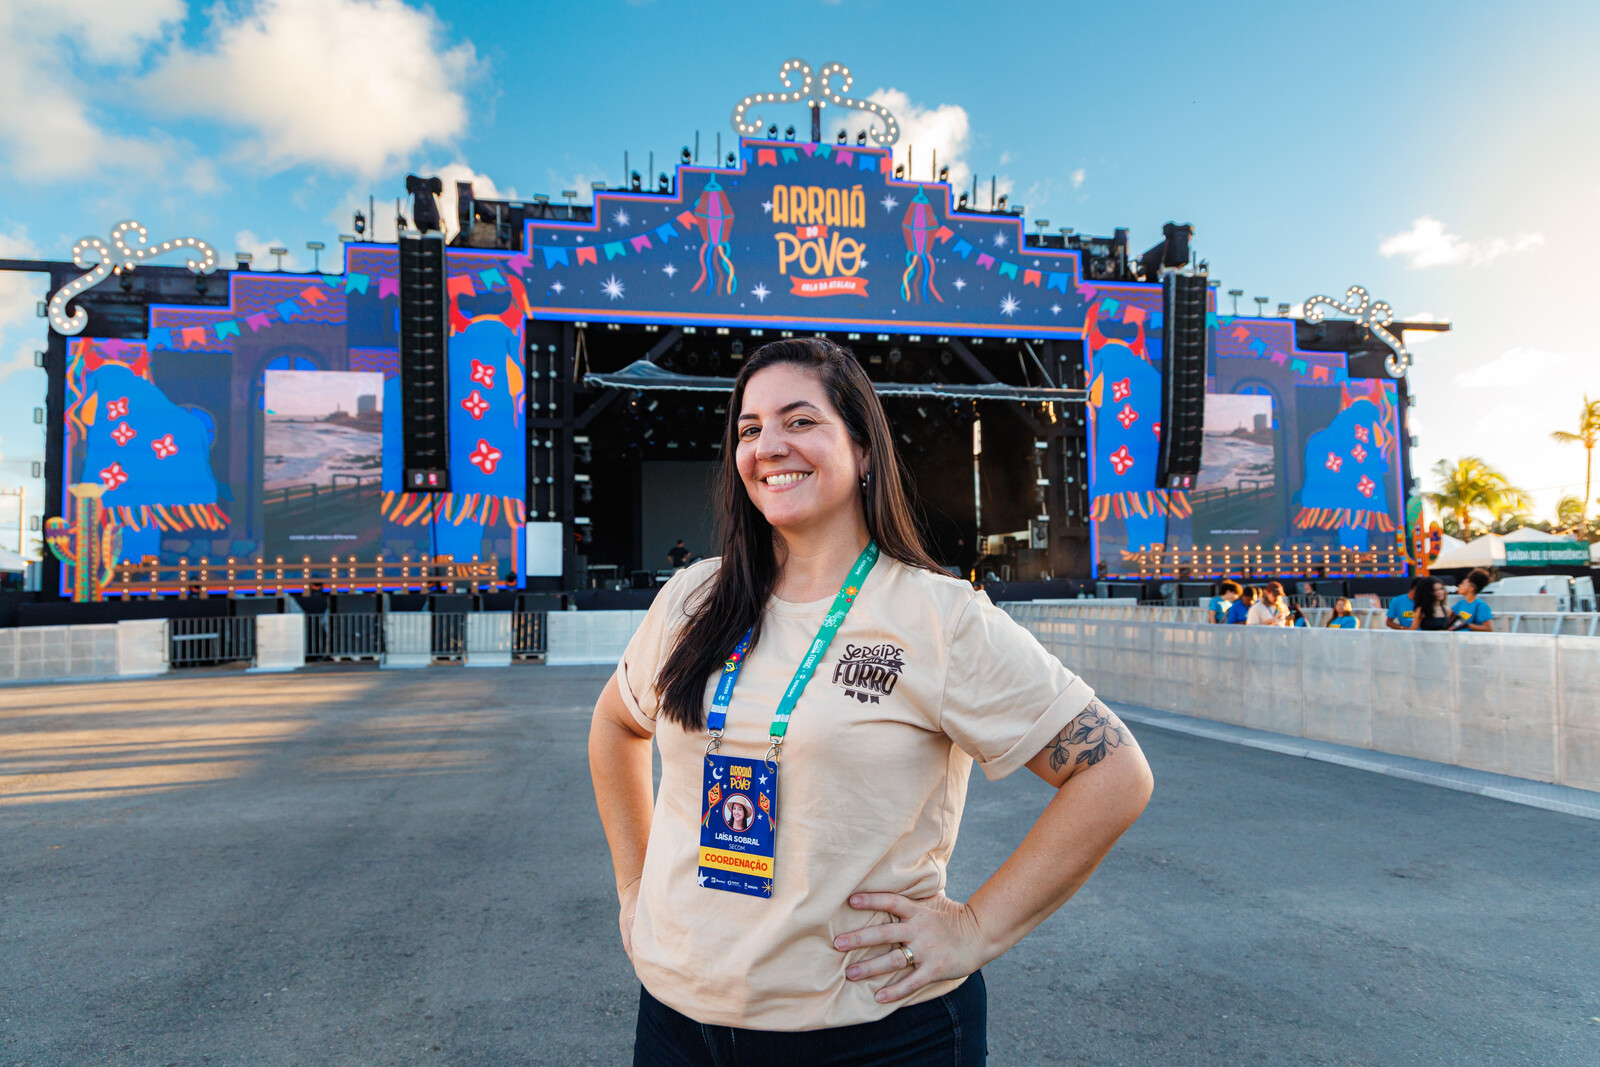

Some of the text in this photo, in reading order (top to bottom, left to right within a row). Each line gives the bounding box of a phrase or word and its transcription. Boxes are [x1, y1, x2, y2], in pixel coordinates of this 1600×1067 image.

[772, 184, 866, 228] ARRAIÁ
[805, 226, 819, 238] DO
[774, 231, 867, 277] POVO
[1531, 550, 1542, 561] DE
[715, 832, 760, 846] LAÍSA SOBRAL
[728, 843, 746, 851] SECOM
[704, 853, 768, 872] COORDENAÇÃO
